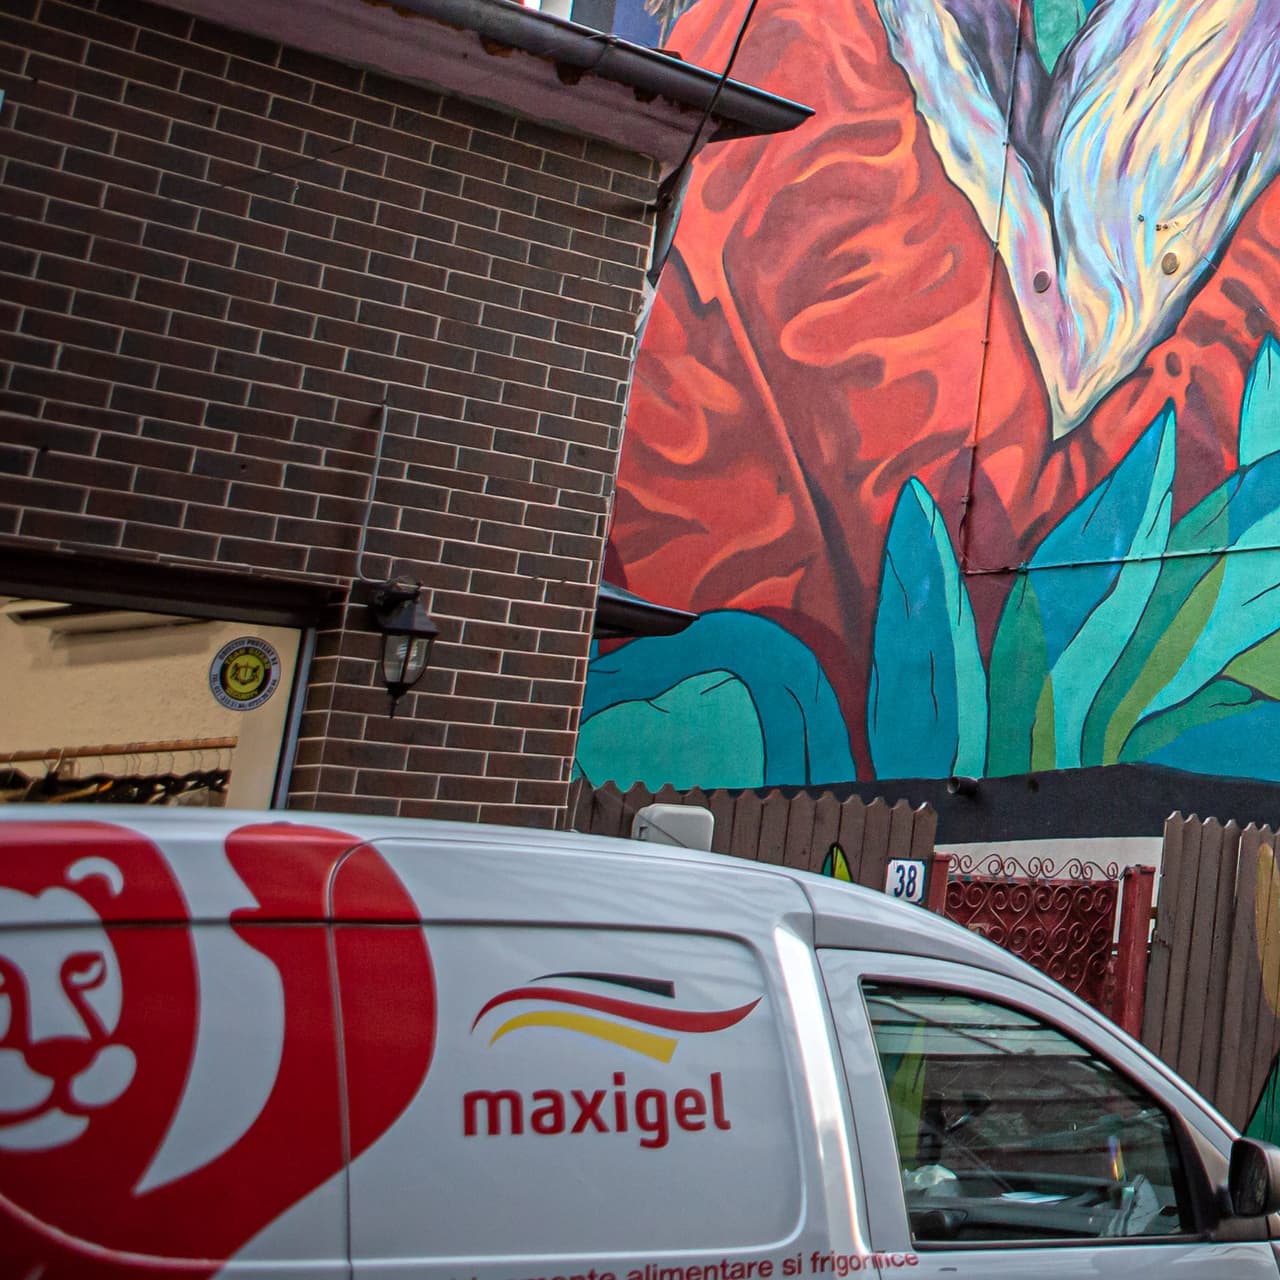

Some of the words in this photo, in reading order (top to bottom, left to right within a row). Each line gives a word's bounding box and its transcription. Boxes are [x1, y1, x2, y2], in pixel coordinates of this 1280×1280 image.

[893, 864, 917, 898] 38
[462, 1071, 732, 1149] maxigel
[626, 1258, 774, 1280] alimentare
[782, 1252, 802, 1277] si
